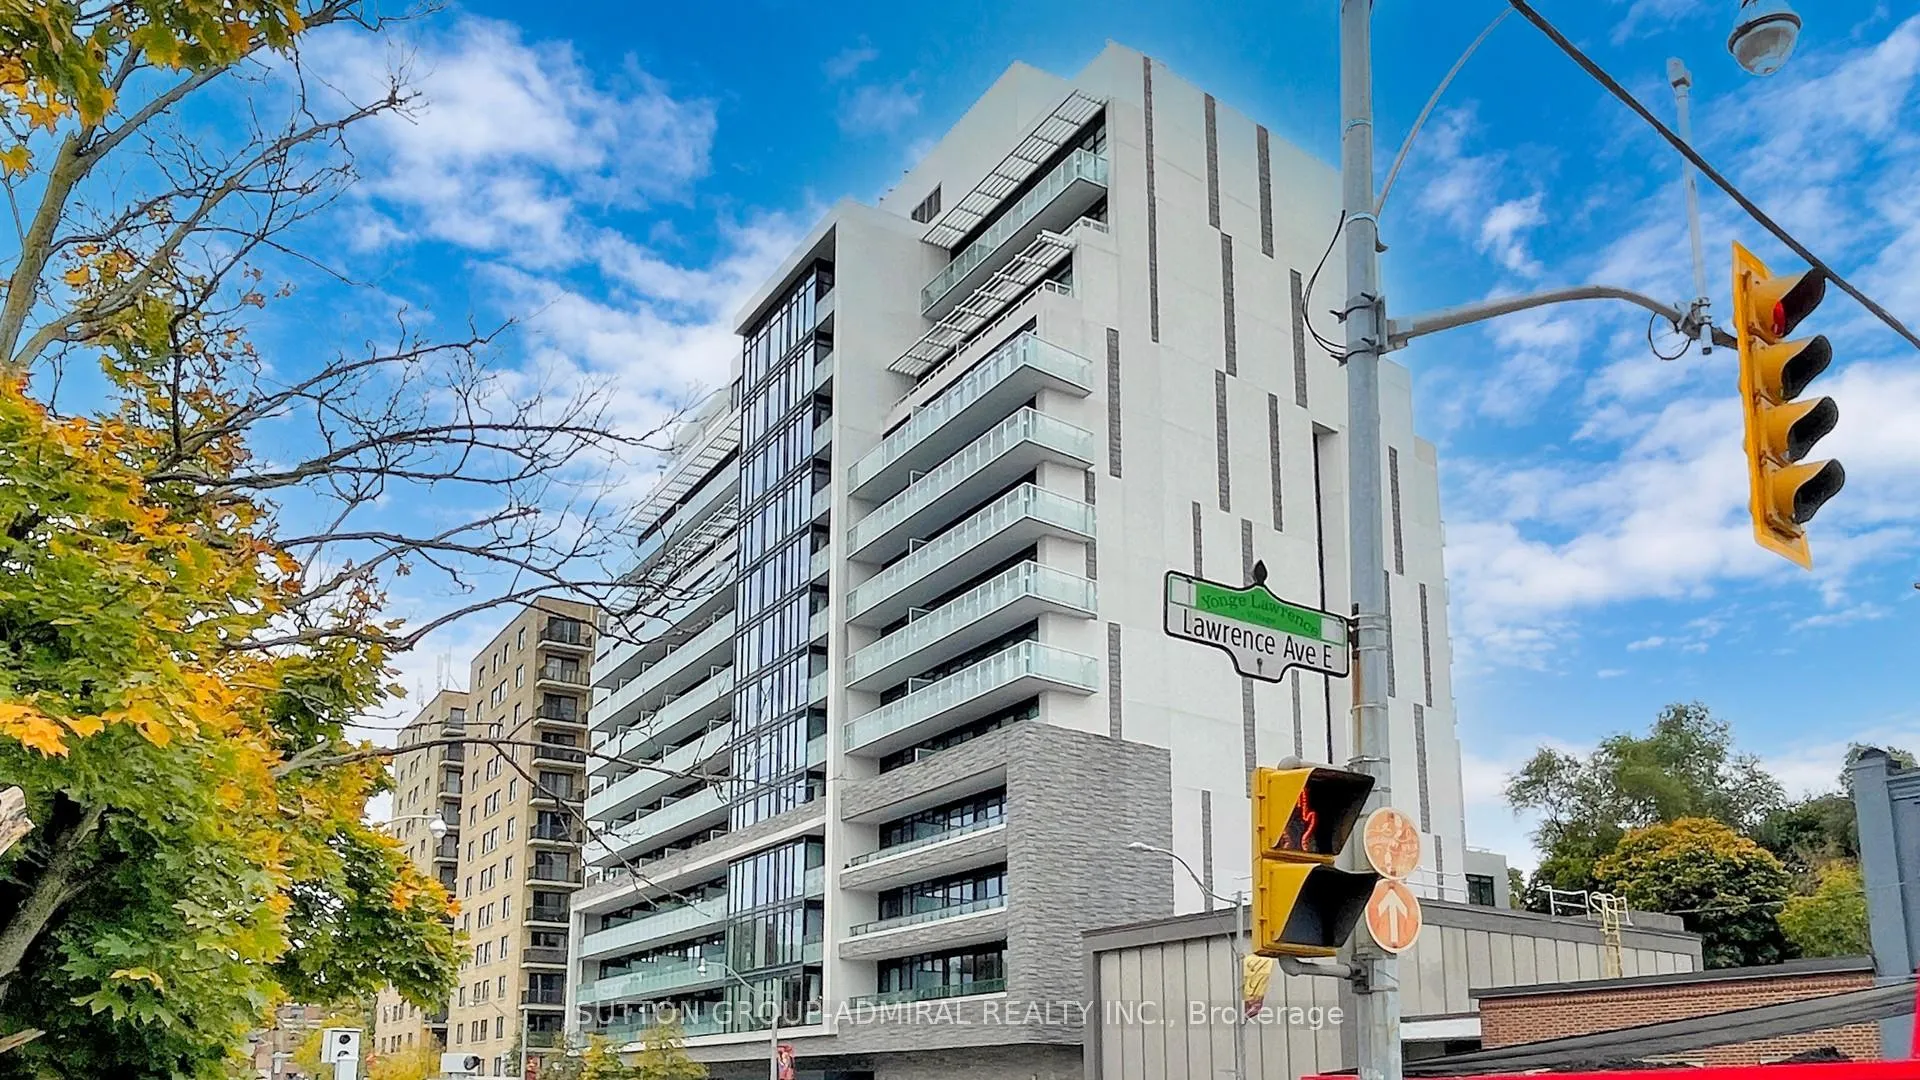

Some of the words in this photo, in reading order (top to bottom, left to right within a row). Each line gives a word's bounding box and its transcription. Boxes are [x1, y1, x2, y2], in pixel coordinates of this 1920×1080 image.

[1184, 609, 1275, 654] Lawrence
[1284, 635, 1316, 664] Ave
[1323, 645, 1333, 669] E
[1201, 594, 1246, 609] Yonge
[1251, 594, 1319, 637] Lawrence
